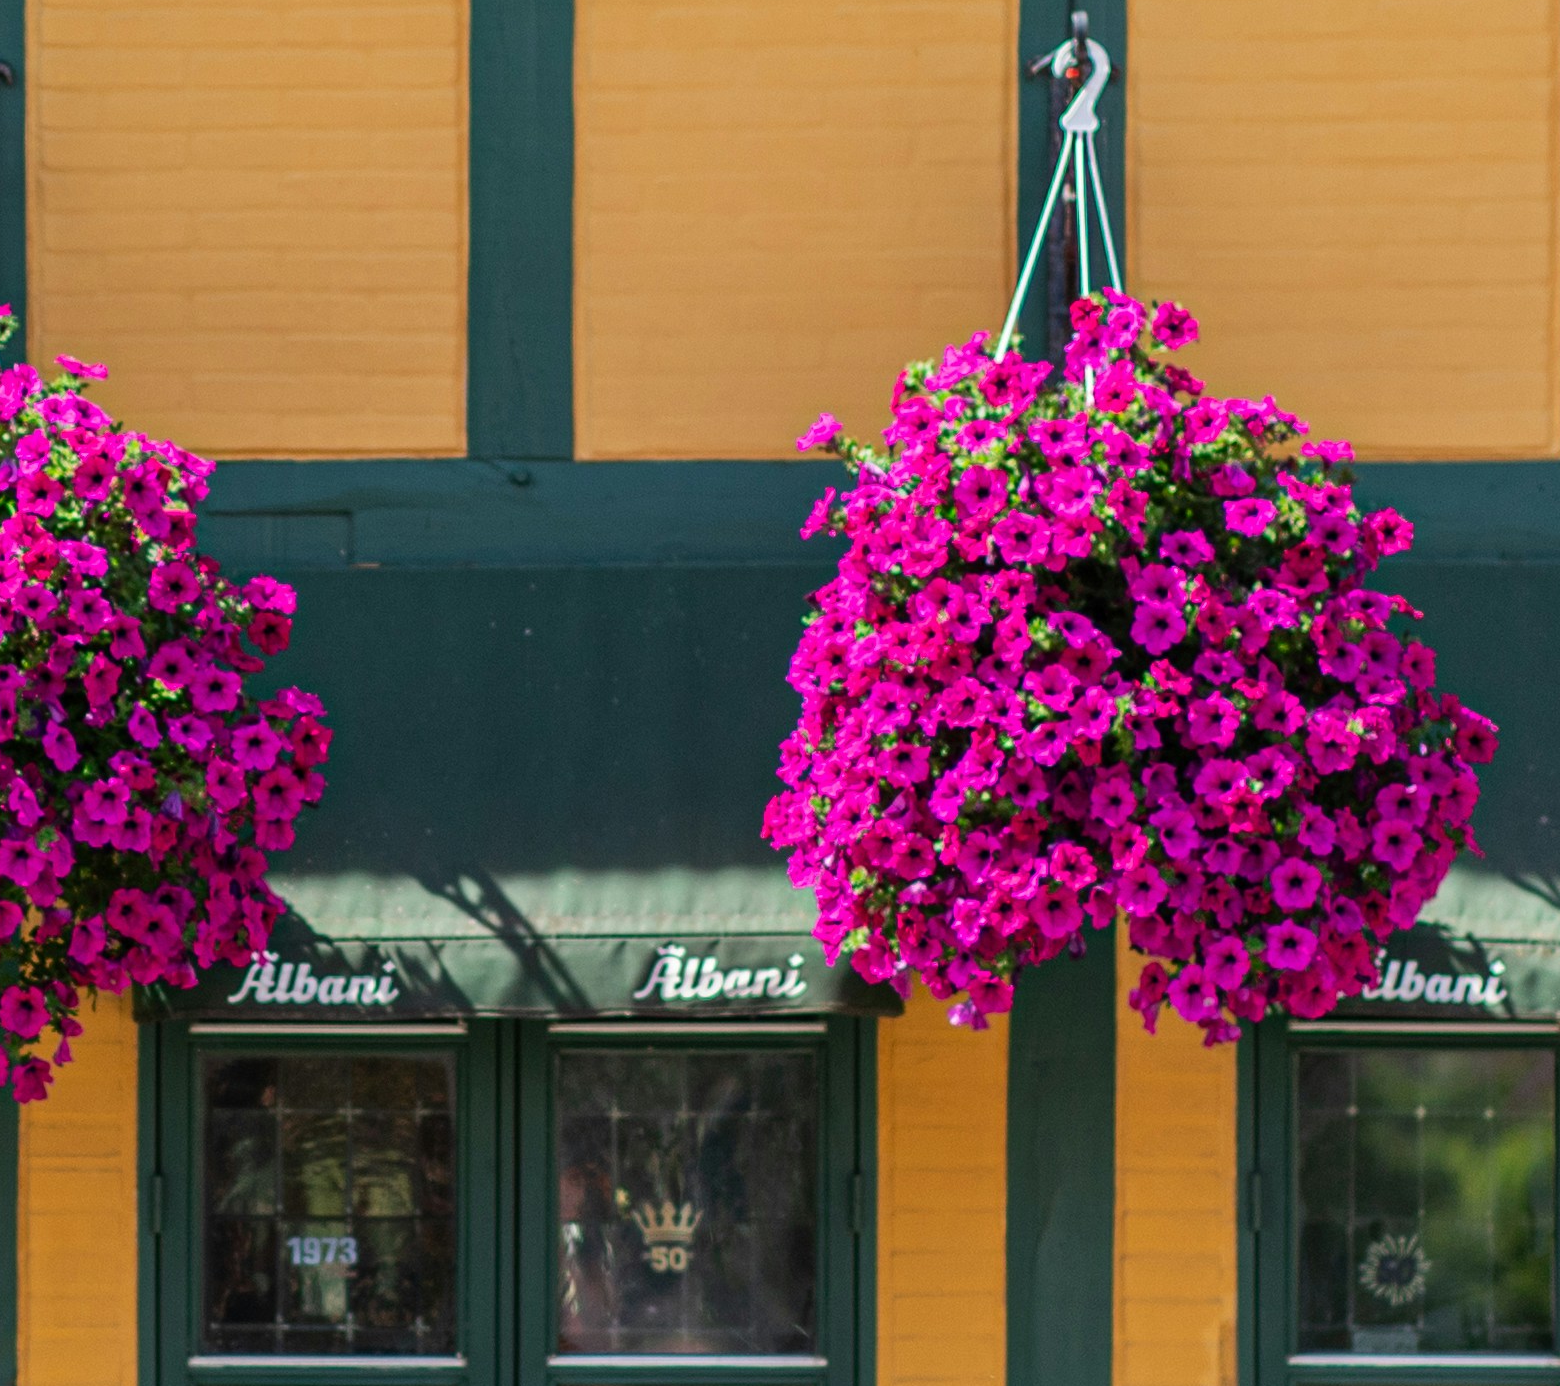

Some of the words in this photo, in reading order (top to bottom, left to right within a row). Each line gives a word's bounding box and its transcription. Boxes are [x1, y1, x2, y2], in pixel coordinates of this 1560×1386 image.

[227, 950, 400, 1004] Albani
[633, 946, 807, 1001] Albani
[287, 1236, 357, 1265] 1973
[651, 1246, 687, 1271] 50
